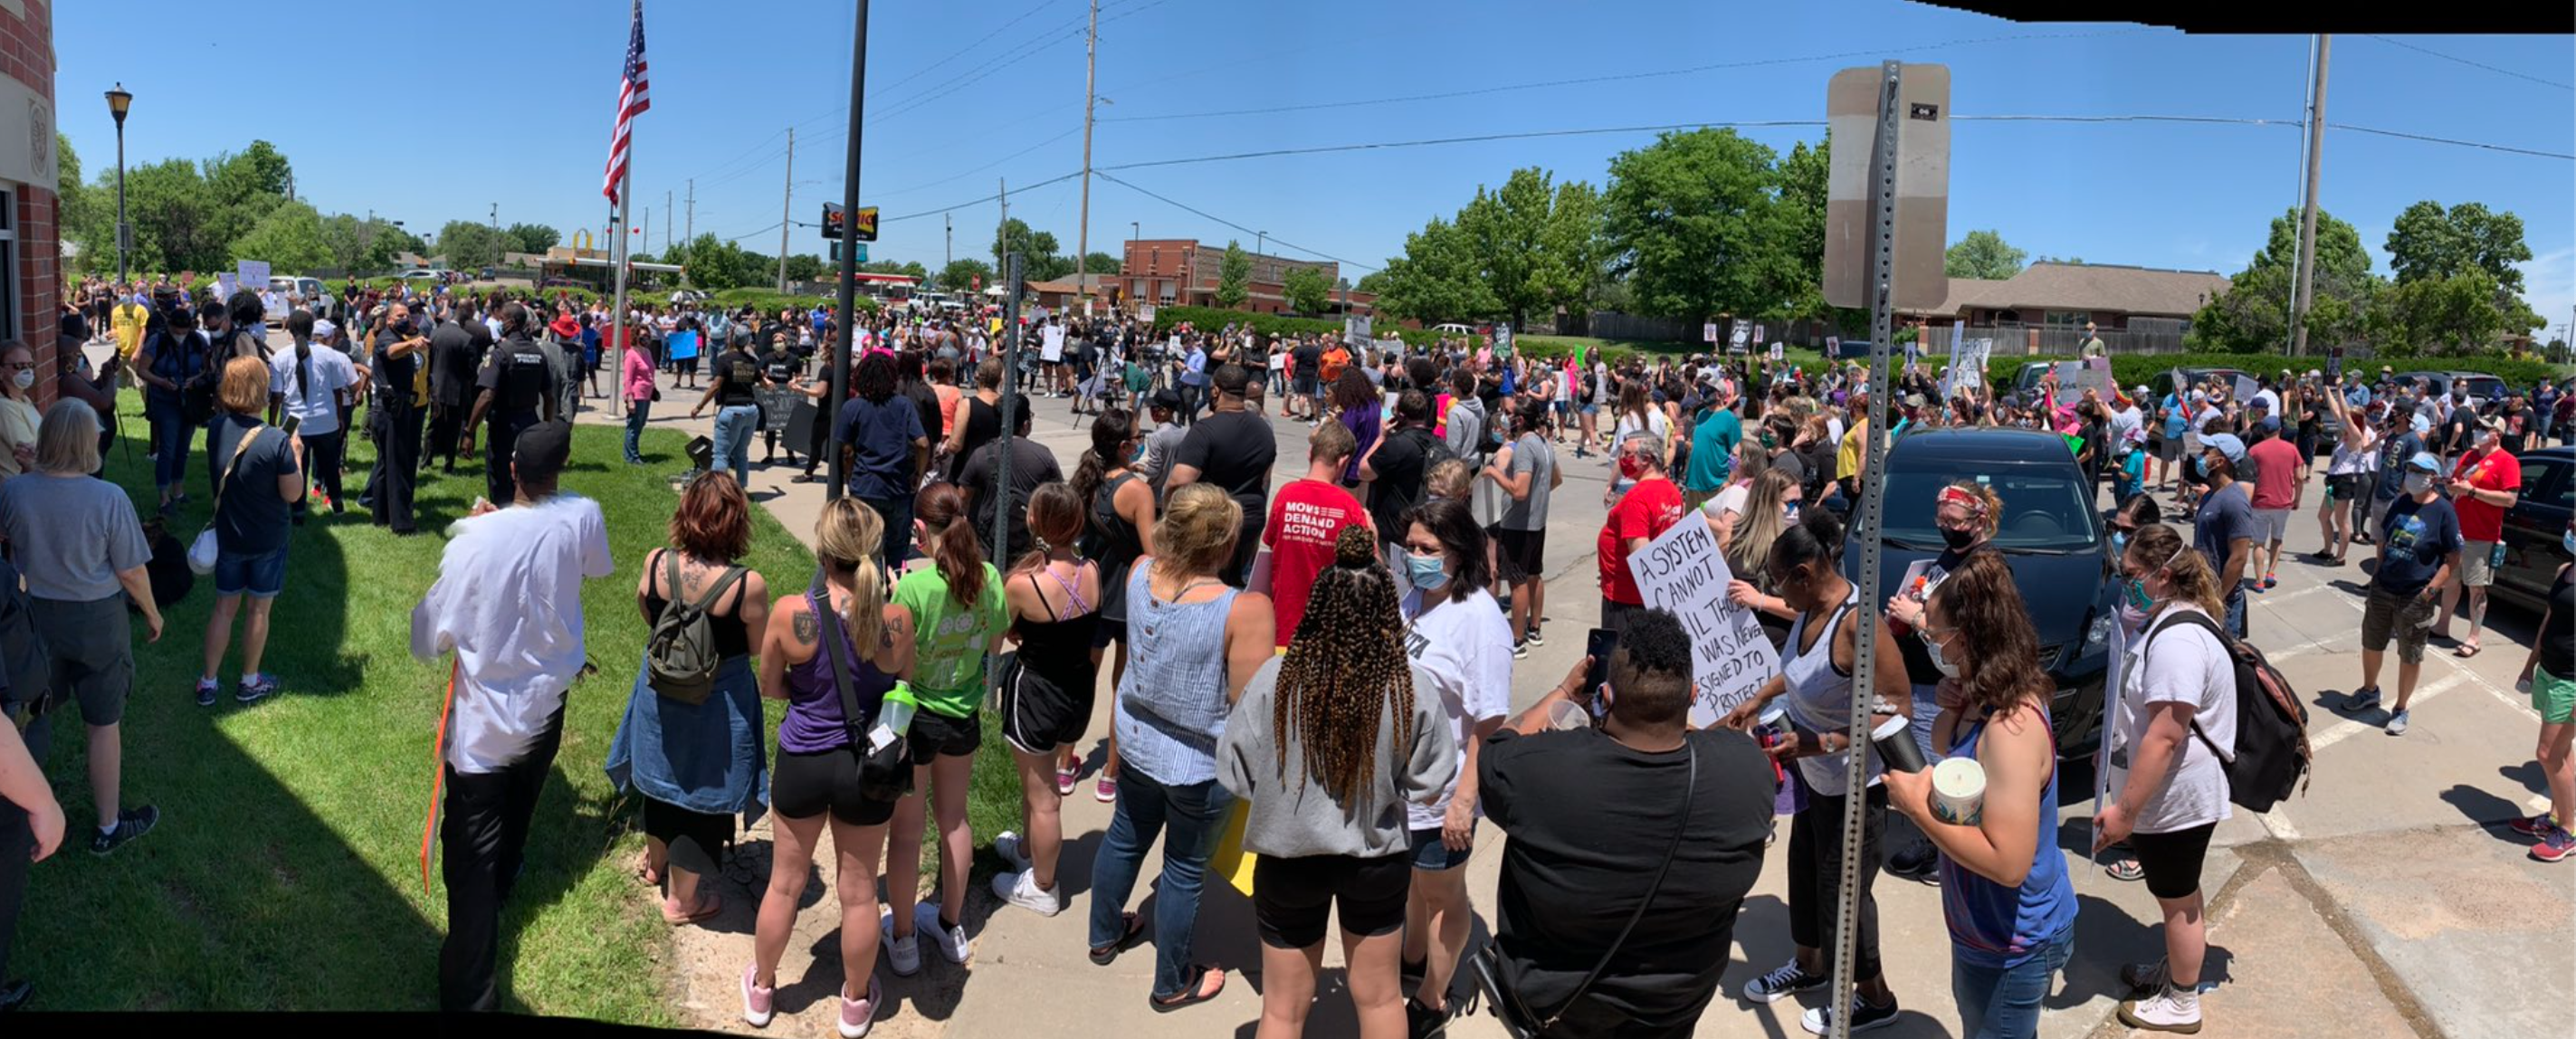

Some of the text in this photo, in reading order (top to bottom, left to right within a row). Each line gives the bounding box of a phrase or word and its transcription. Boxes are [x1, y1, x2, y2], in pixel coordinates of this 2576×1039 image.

[1283, 524, 1326, 539] ACTION
[1639, 527, 1710, 585] A SYSTEM
[1655, 554, 1714, 607] CANNOT
[1698, 634, 1735, 663] WAS
[1743, 650, 1764, 669] TO
